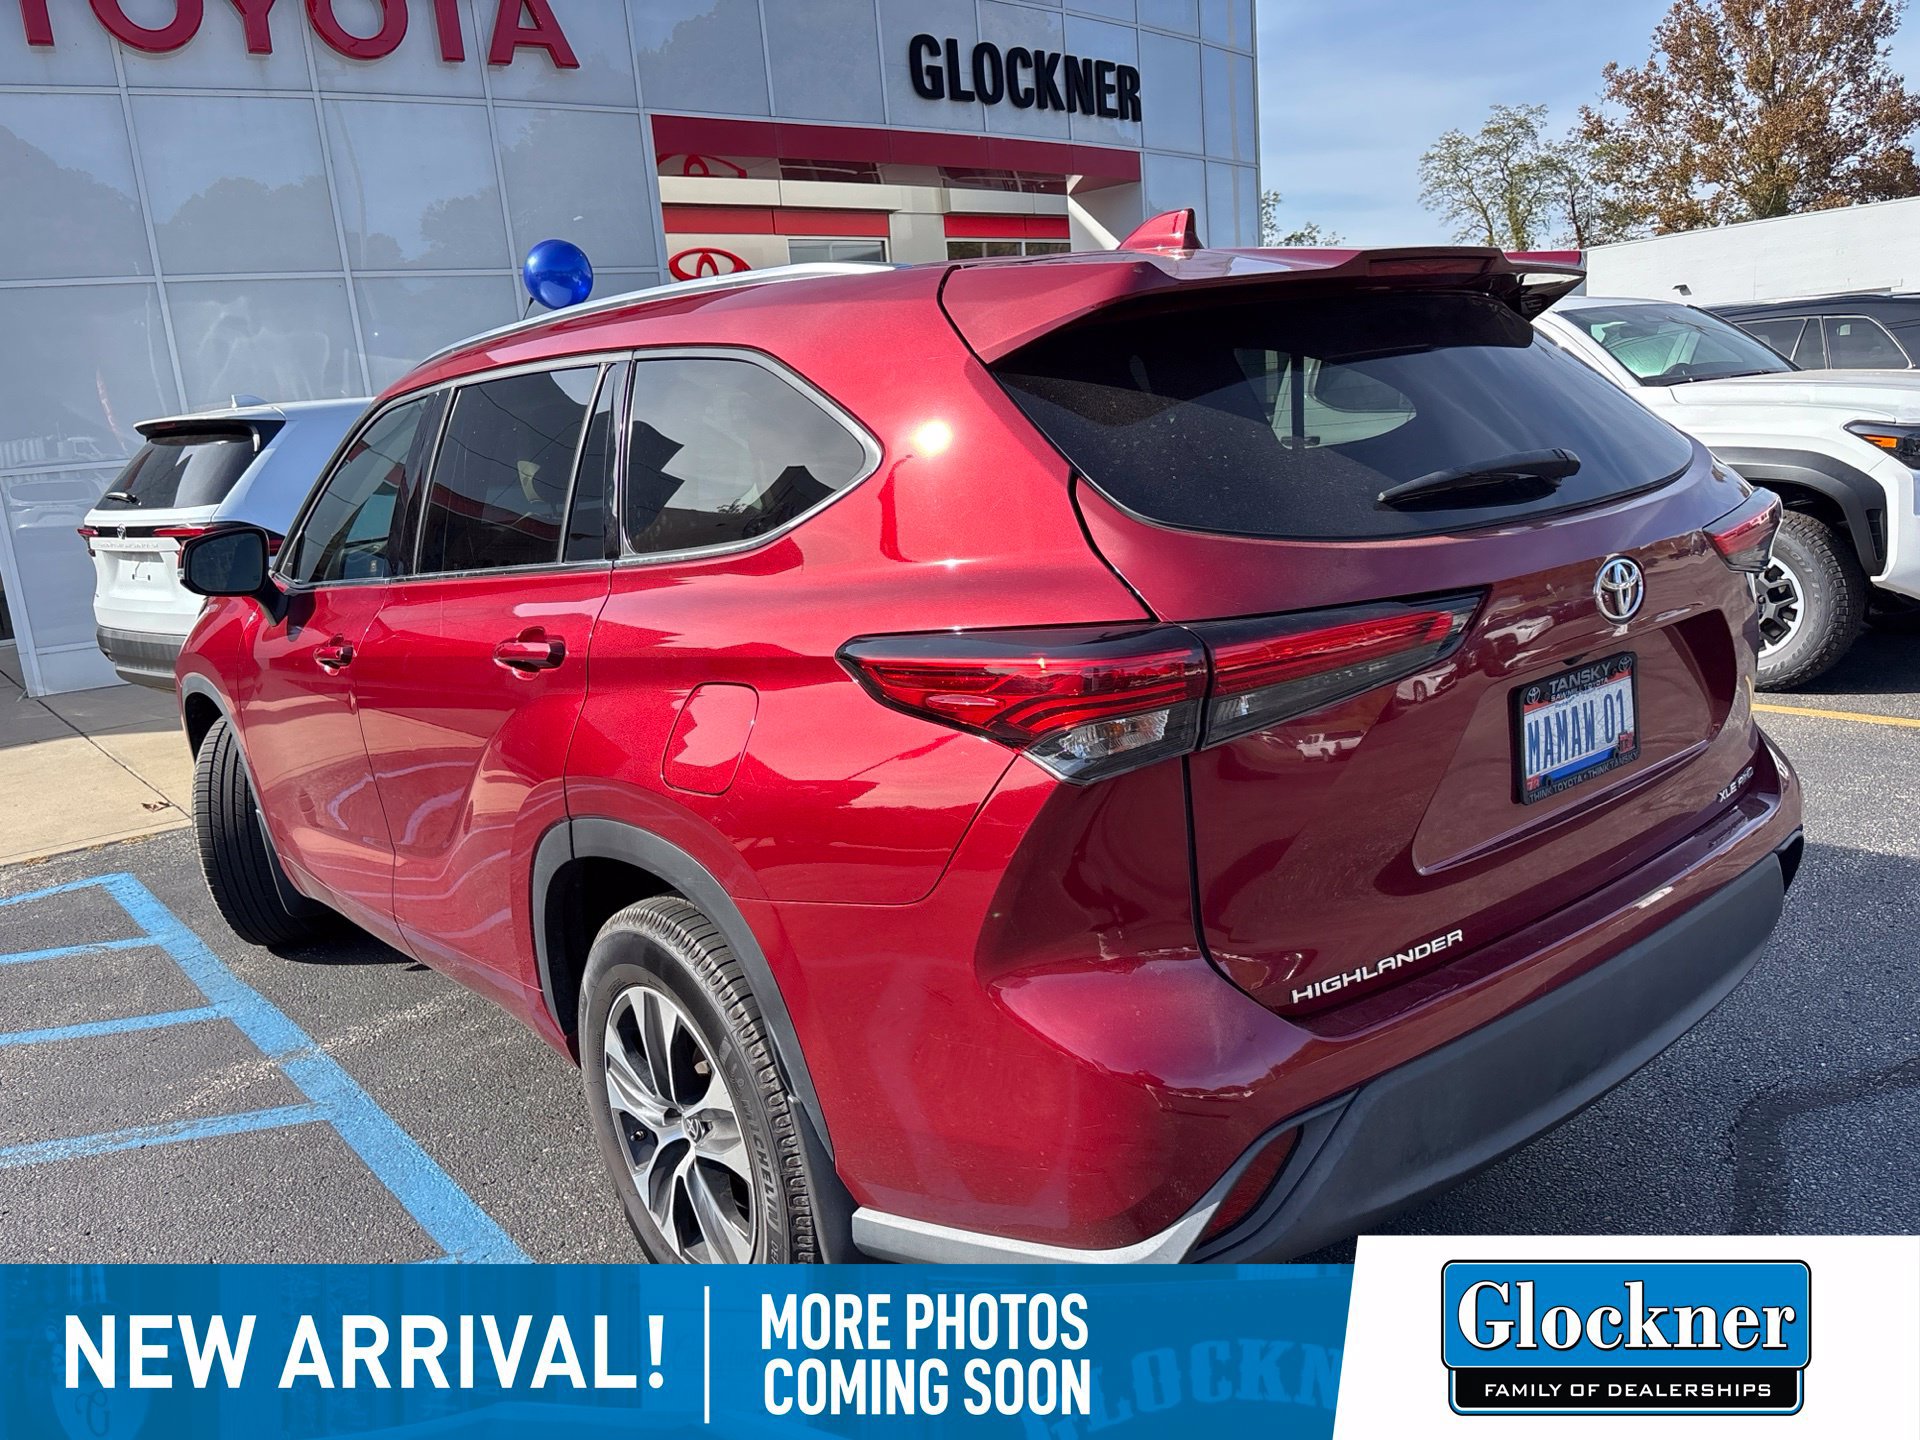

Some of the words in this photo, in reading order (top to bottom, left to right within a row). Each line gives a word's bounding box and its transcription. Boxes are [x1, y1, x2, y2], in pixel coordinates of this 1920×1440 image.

[909, 33, 1142, 123] GLOCKNER
[1549, 661, 1611, 694] TANSKY
[1527, 699, 1596, 776] MAMAW
[1529, 786, 1552, 803] THINK
[1553, 777, 1583, 793] TOYOTA
[1588, 764, 1610, 779] THINK
[1611, 751, 1639, 768] TANSKY
[1718, 781, 1738, 803] XLE
[1291, 929, 1464, 1004] HIGHLANDER
[742, 1099, 779, 1230] MICHELIN
